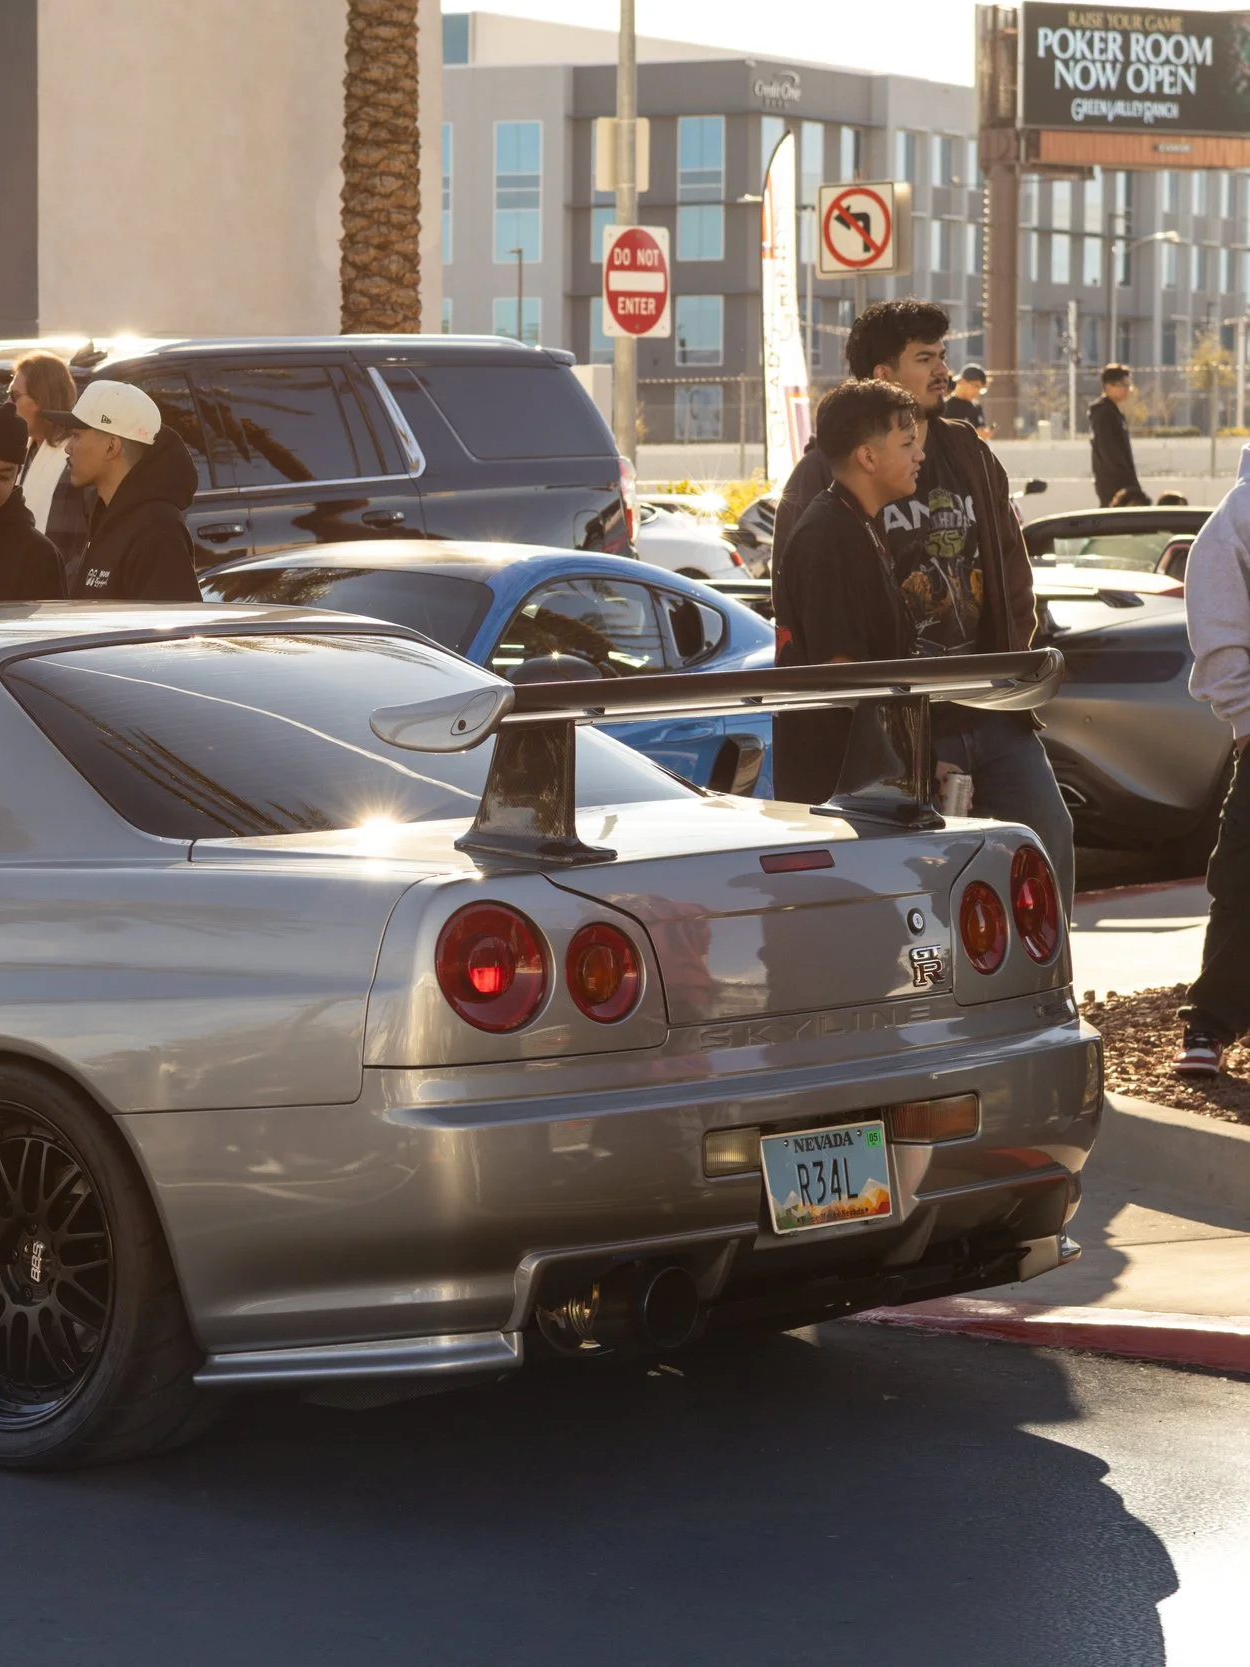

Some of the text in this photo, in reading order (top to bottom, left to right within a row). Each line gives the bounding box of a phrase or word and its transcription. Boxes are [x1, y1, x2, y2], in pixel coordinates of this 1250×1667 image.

[1068, 11, 1183, 32] RAISE YOUR GAME
[1038, 27, 1213, 66] POKER ROOM
[1054, 60, 1197, 95] NOW OPEN
[614, 247, 659, 266] DO NOT
[617, 296, 656, 315] ENTER
[910, 945, 942, 961] GT
[913, 959, 945, 987] R
[700, 1004, 931, 1050] SKYLINE
[793, 1131, 854, 1153] NEVADA
[796, 1157, 858, 1207] R34L
[31, 1242, 44, 1282] BBS
